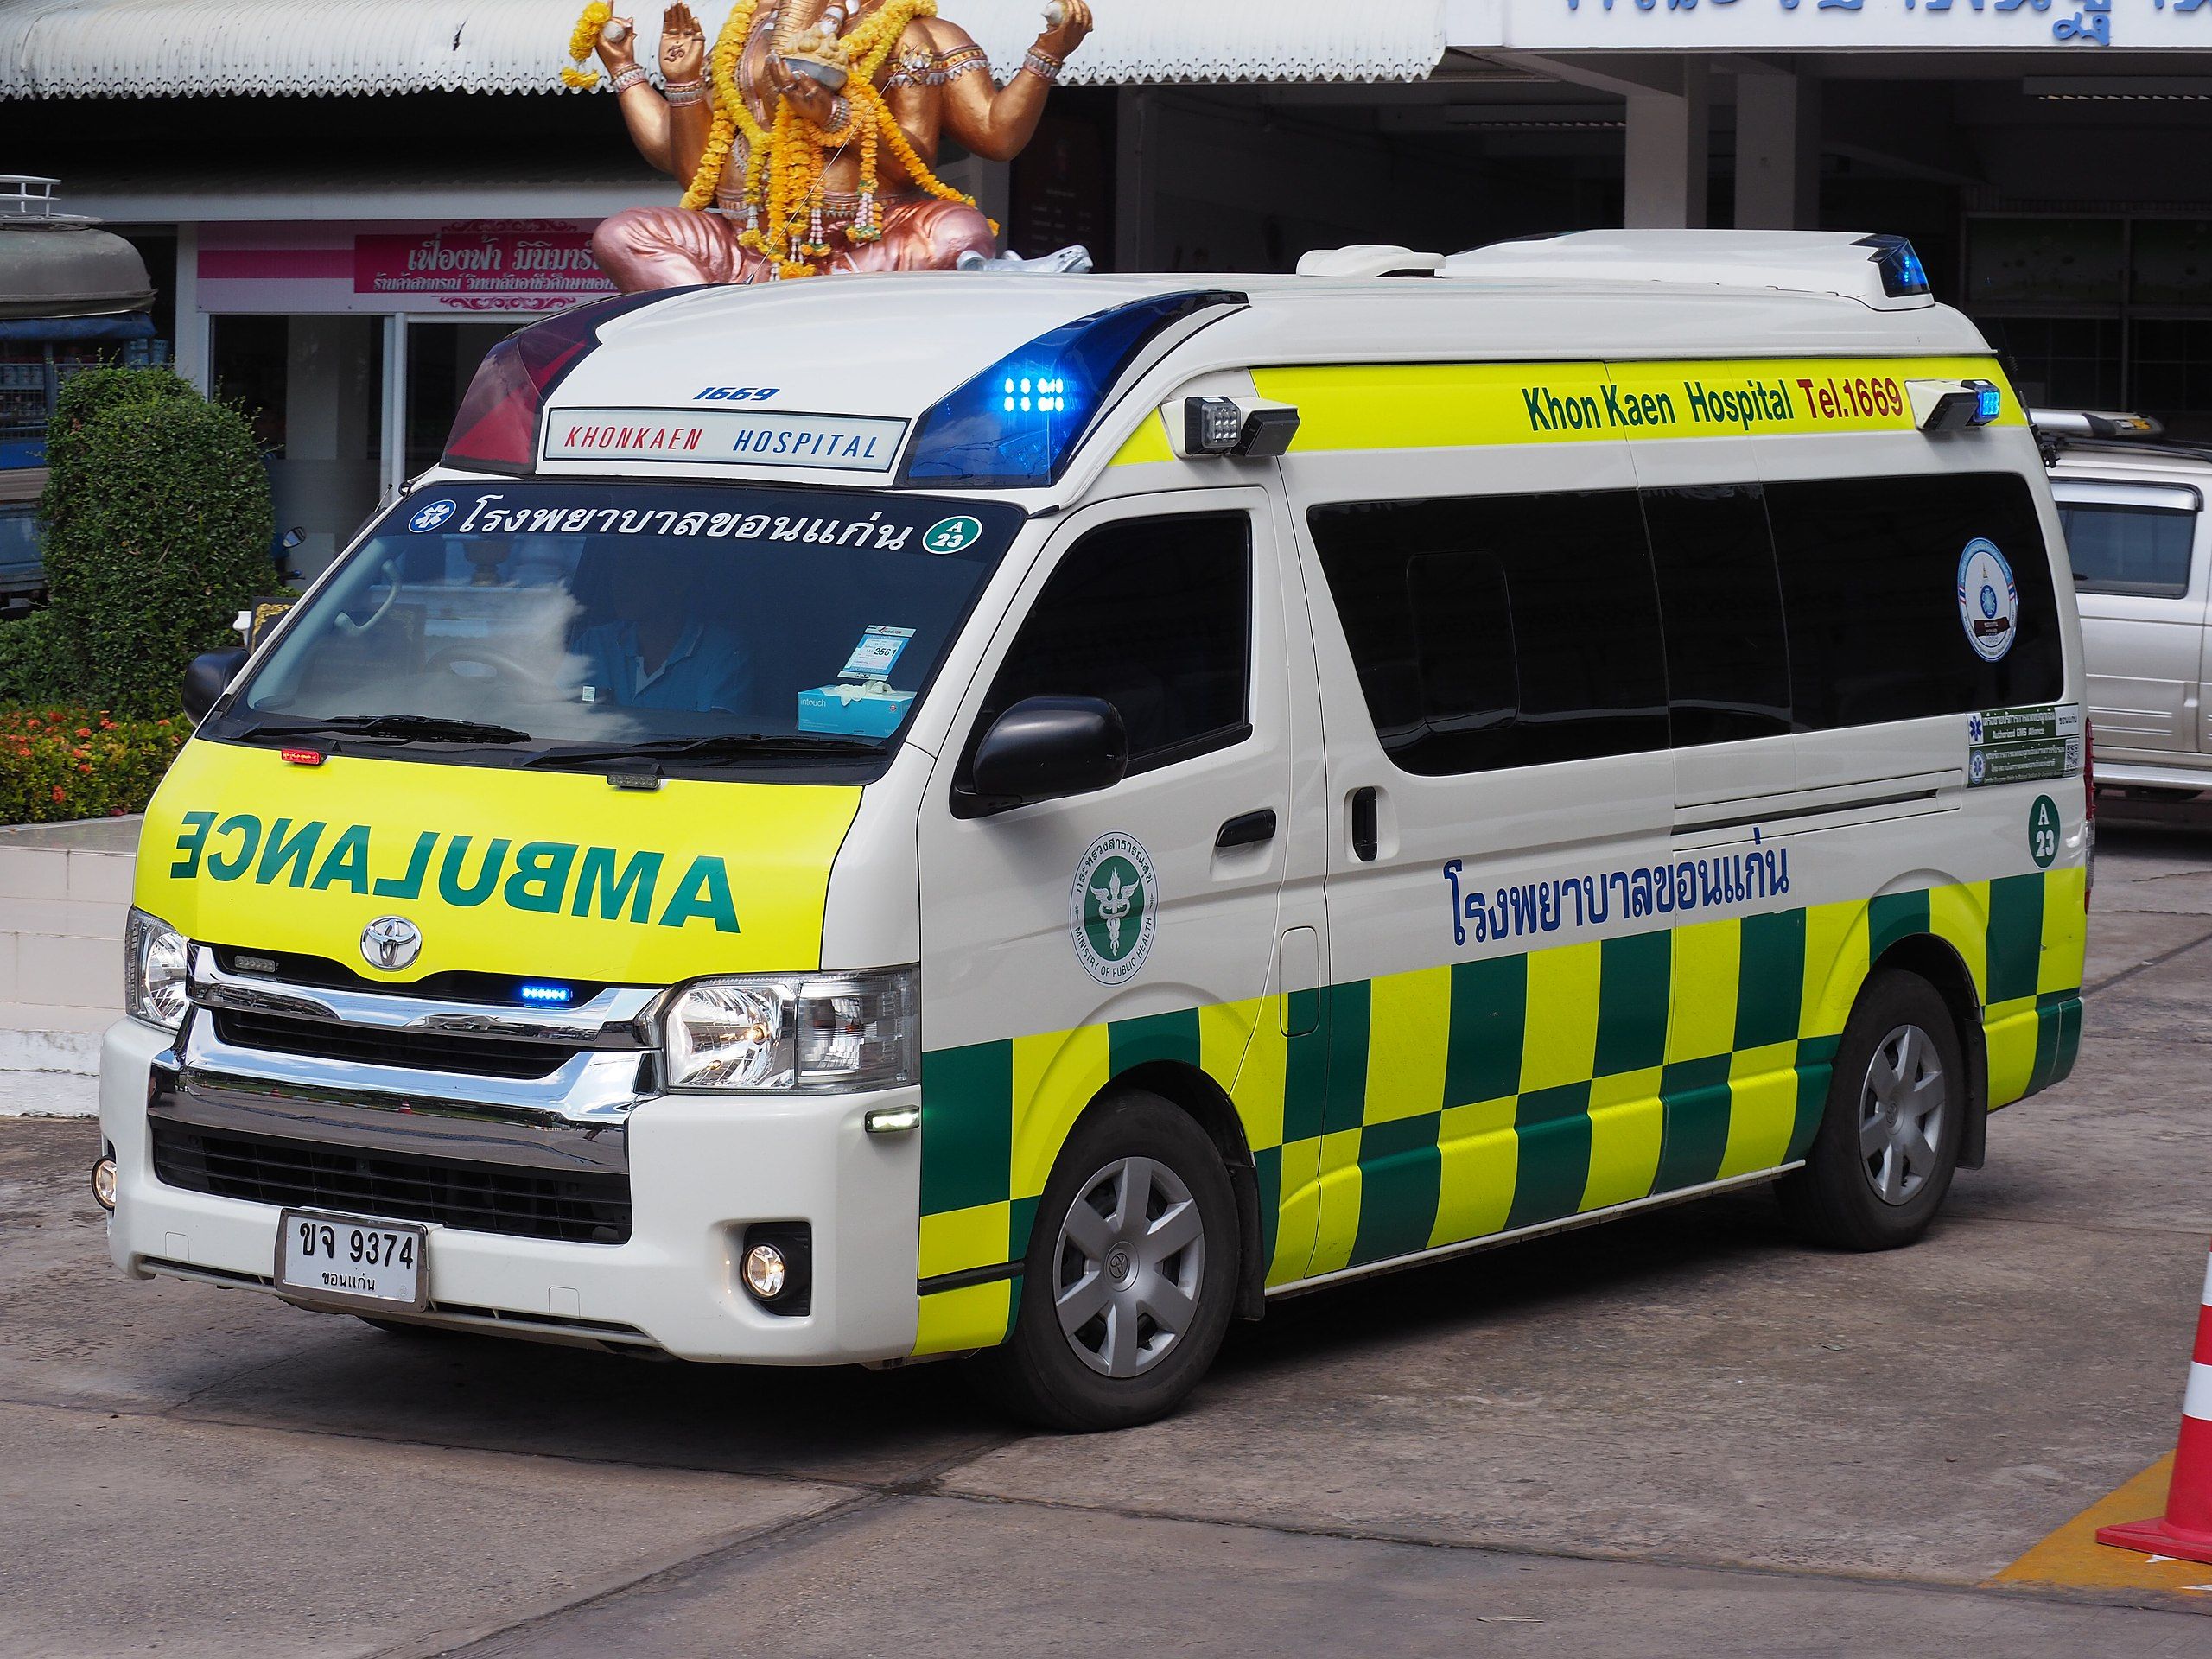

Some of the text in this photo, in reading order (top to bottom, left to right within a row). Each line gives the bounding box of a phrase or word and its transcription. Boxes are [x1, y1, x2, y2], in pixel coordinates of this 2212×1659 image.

[408, 233, 502, 270] เฟื่องฟ้า
[373, 272, 461, 291] ร้านค้าสหกรณ์
[692, 386, 780, 401] 1669
[1522, 378, 1904, 431] Khon Kaen Hospital Tel.1669
[564, 426, 880, 458] KHONKAEN HOSPITAL
[459, 494, 913, 550] โรงพยาบาลขอนแก่น
[946, 521, 963, 533] A
[931, 533, 963, 548] 23
[800, 697, 827, 707] intouch
[2037, 804, 2050, 825] A
[2036, 830, 2055, 857] 23
[1076, 837, 1154, 893] กระทรวงสาธารณสุข
[1443, 826, 1790, 947] โรงพยาบาลขอนแก่น
[1075, 916, 1153, 978] MINISTRY OF PUBLIC HEALTH
[299, 1222, 414, 1270] ขจ 9374
[321, 1272, 376, 1291] ขอนแก่น
